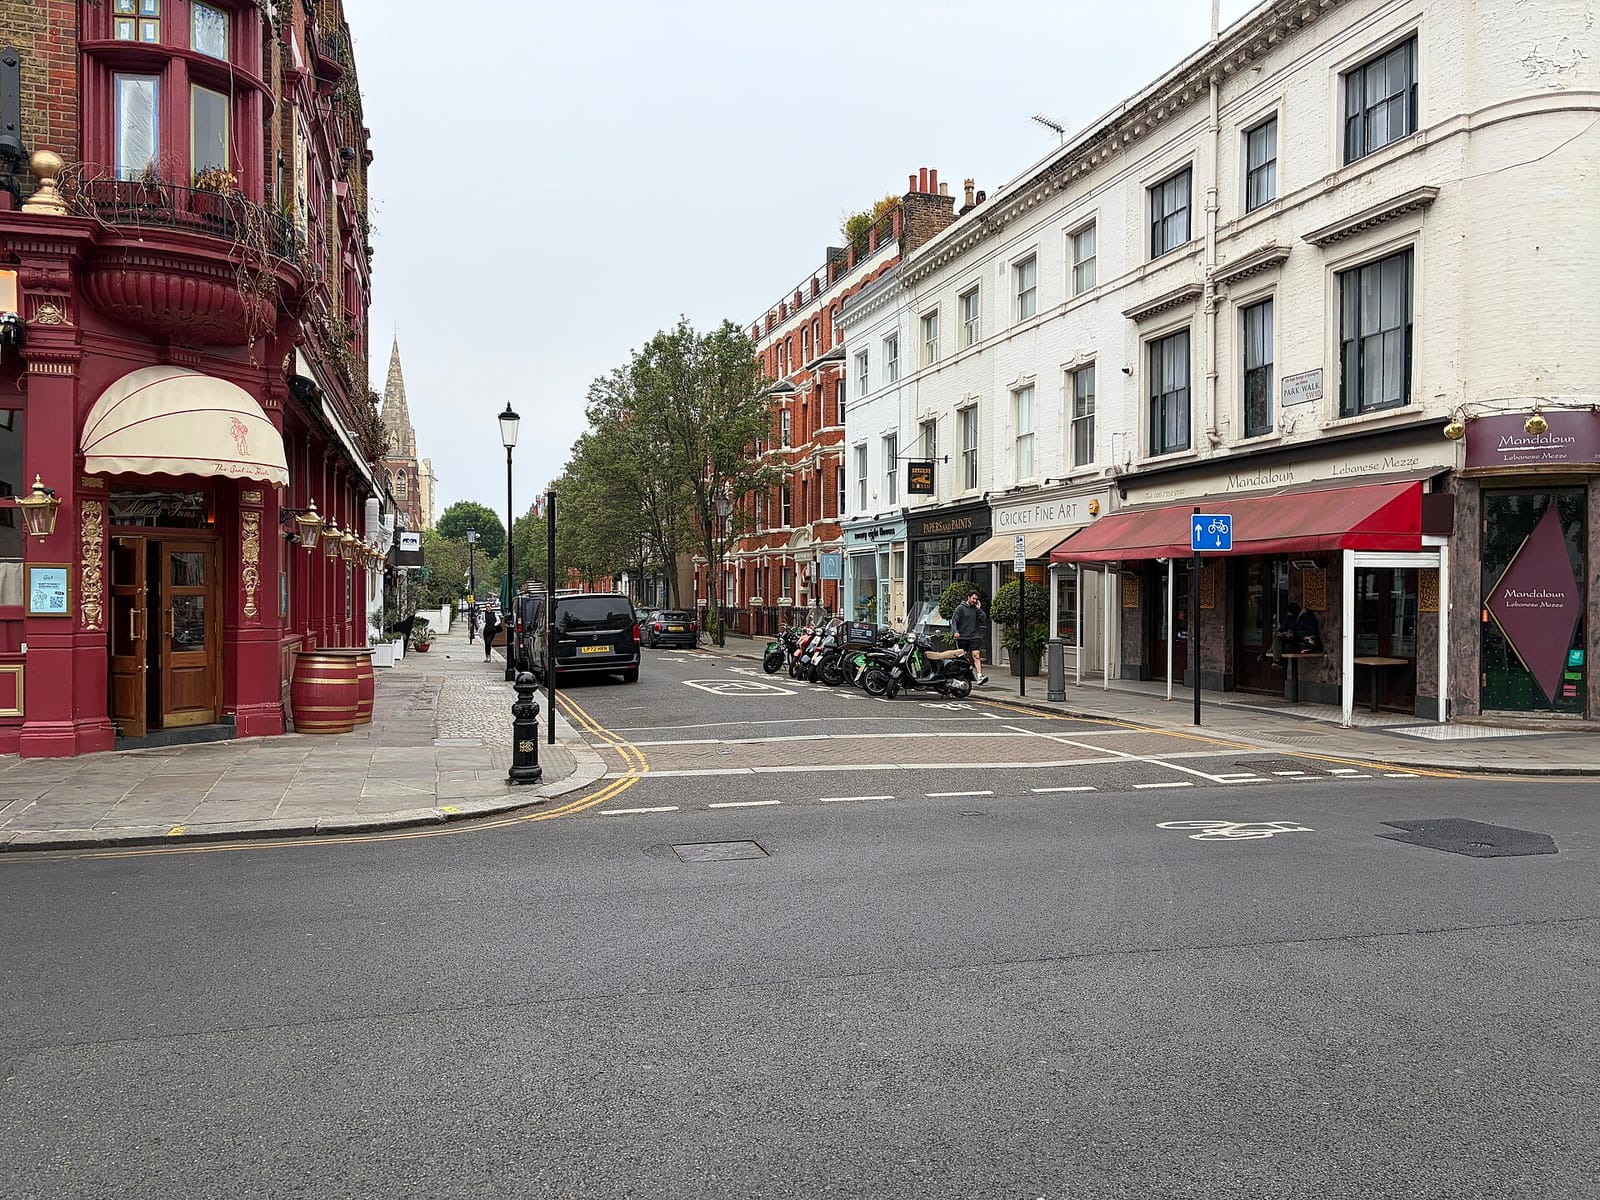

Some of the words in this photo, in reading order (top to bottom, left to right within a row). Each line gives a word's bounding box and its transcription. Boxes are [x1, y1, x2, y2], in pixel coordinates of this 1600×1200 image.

[1283, 387, 1300, 397] PARK
[1301, 382, 1320, 392] WALK
[1305, 389, 1321, 400] SW10
[1498, 432, 1575, 447] Mandaloun
[1503, 453, 1540, 461] Lebanese
[1541, 452, 1568, 460] Mezze
[214, 463, 228, 472] The
[1332, 463, 1380, 475] Lebanese
[1381, 456, 1420, 470] Mezze
[1226, 466, 1294, 491] Mandaloun
[999, 509, 1032, 526] CRICKET
[1035, 506, 1054, 521] FINE
[1057, 503, 1077, 519] ART
[951, 516, 972, 530] PAINTS
[1503, 588, 1565, 599] Mandaloun
